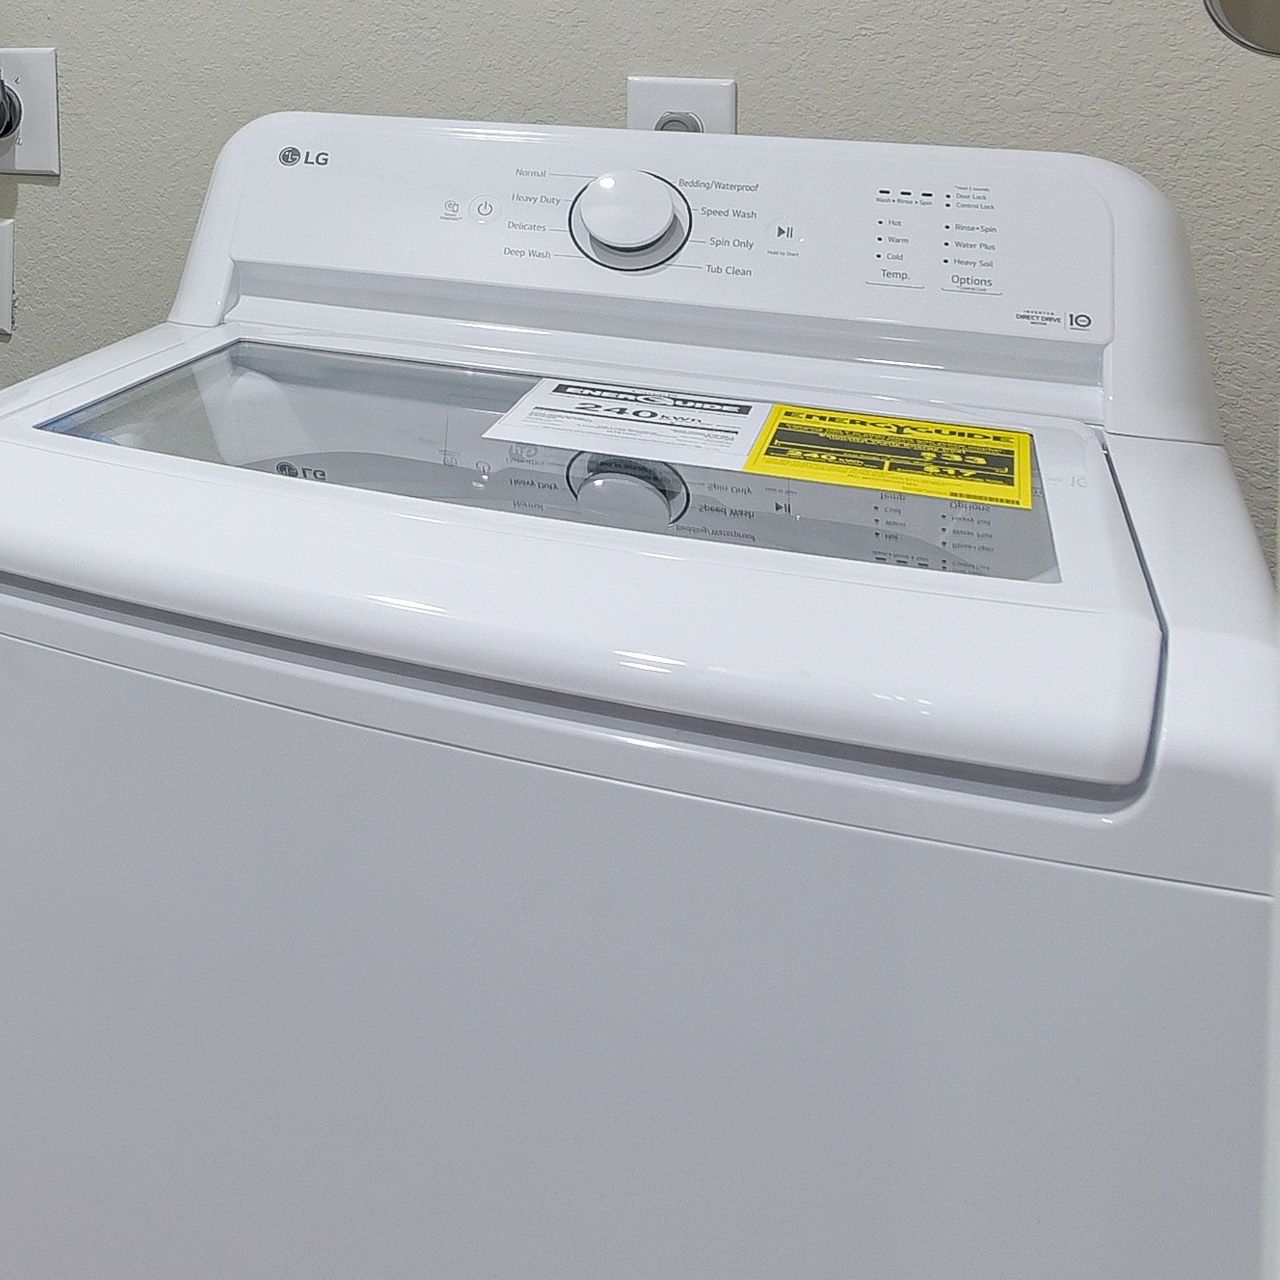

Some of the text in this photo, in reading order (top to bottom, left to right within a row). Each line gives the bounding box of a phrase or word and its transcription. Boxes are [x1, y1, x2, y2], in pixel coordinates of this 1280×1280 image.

[303, 150, 330, 167] LG
[514, 168, 548, 179] Normal
[678, 178, 760, 193] Bedding/Waterproof
[511, 192, 562, 207] Heavy Duty
[955, 201, 979, 209] Control
[700, 206, 758, 220] Speed Wash
[507, 220, 548, 232] Delicates
[887, 218, 903, 227] Hot
[954, 223, 998, 234] Rinse+Spin
[708, 236, 755, 251] Spin Only
[887, 236, 910, 245] Warm
[954, 241, 996, 252] Water Plus
[502, 246, 552, 260] Deep Wash
[886, 252, 904, 261] Cold
[953, 257, 994, 268] Heavy Soil
[706, 264, 753, 277] Tub Clean
[880, 268, 911, 282] Temp.
[951, 274, 993, 288] Options
[1015, 313, 1062, 323] DIRECT DRIVE
[1068, 313, 1092, 328] 10
[564, 385, 742, 414] ENERGUIDE
[574, 401, 659, 420] 240
[783, 409, 1016, 443] ENERGYGUIDE
[920, 451, 988, 465] $33
